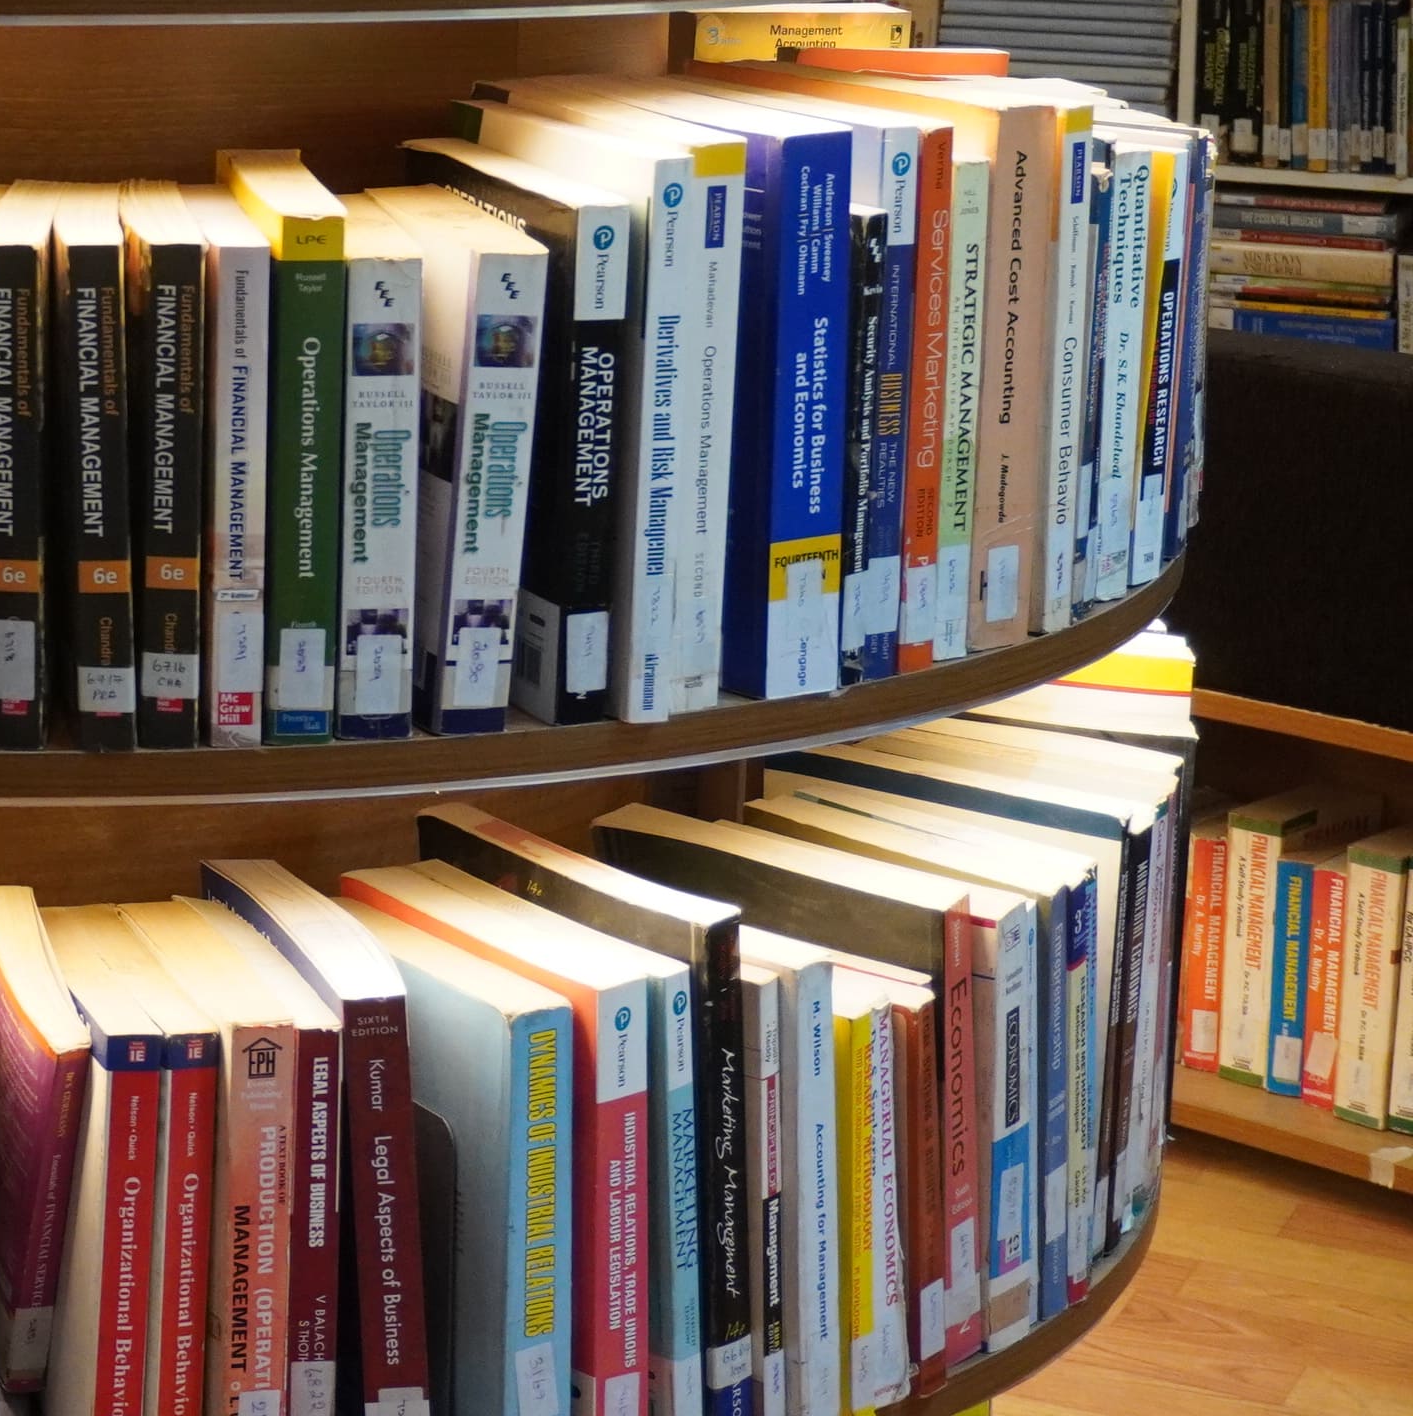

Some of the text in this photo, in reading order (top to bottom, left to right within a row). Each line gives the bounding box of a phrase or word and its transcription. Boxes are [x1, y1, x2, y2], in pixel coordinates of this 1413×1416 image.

[770, 25, 843, 39] Management
[595, 254, 609, 309] Pearson
[998, 151, 1027, 424] Advanced Cost Accounting
[1112, 172, 1133, 303] Techniques
[1130, 164, 1149, 308] Quantitative
[16, 288, 30, 418] Fundamentals of
[917, 209, 948, 468] Services Marketing
[952, 243, 979, 531] STRATEGIC MANAGEMENT
[293, 336, 321, 579] Operations Management
[696, 346, 717, 535] Operations Management
[793, 353, 808, 489] and Economics
[810, 318, 828, 514] Statistics for Business
[2, 566, 26, 584] 6e
[1245, 835, 1267, 970] FINANCIAL MANAGEMENT
[1282, 876, 1302, 1022] FINANCIAL MANAGEMENT
[950, 977, 967, 1176] Economics
[1006, 1012, 1019, 1123] ECONOMICS
[523, 1029, 556, 1336] DYNAMICS OF INDUSTRIAL RELATIONS
[624, 1112, 636, 1368] INDUSTRIAL RELATIONS, TRADE UNIONS
[716, 1048, 740, 1297] Marketing Management
[815, 1124, 825, 1209] Accounting
[117, 1177, 141, 1331] Organizational
[370, 1135, 400, 1366] Legal Aspects of Business
[609, 1160, 621, 1330] AND LABOUR LEGISLATION
[818, 1240, 827, 1339] Management
